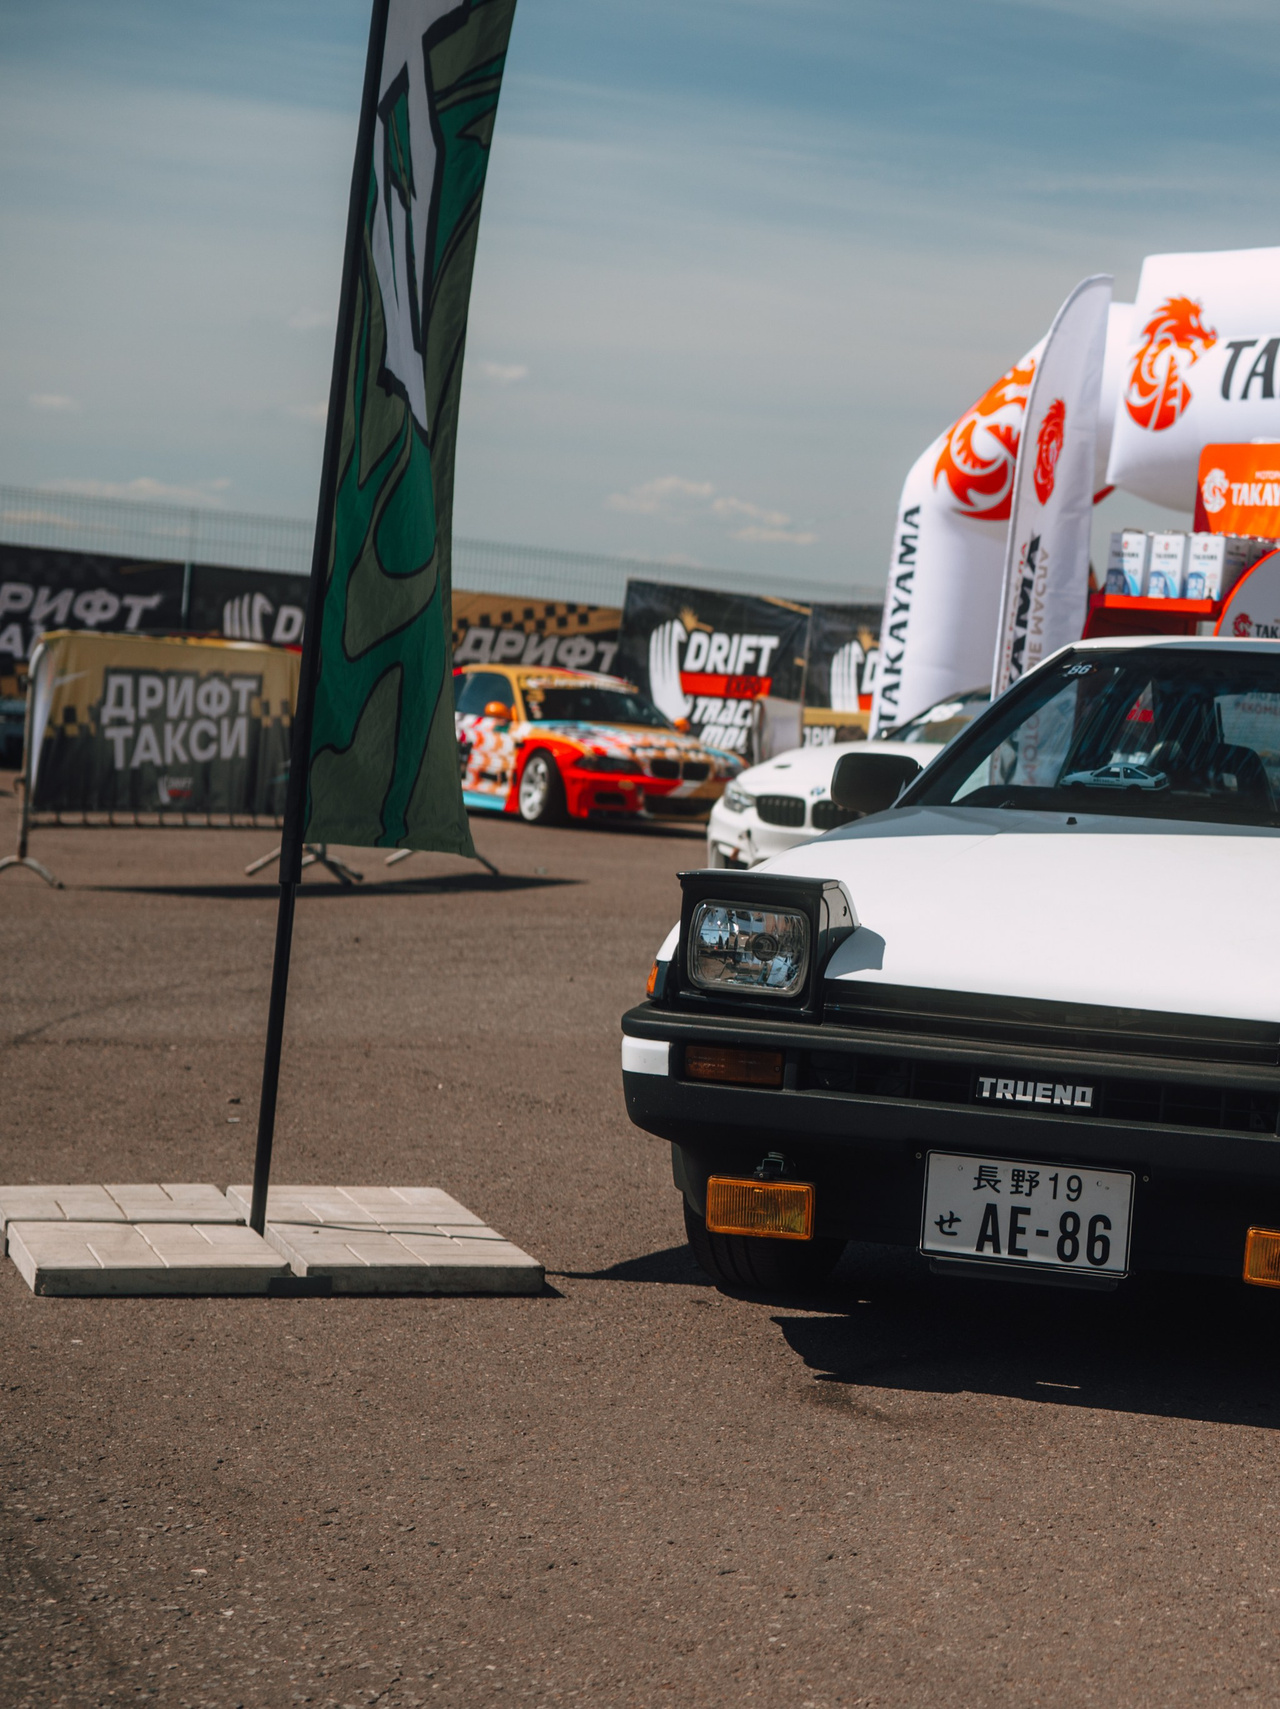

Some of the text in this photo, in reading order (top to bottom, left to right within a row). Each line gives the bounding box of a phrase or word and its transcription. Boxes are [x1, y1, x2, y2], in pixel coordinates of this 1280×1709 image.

[0, 581, 164, 631] РИФТ
[879, 505, 921, 723] TAKAYAMA
[454, 626, 619, 674] ДРИФТ
[683, 631, 780, 677] DRIFT
[1067, 664, 1093, 675] 86
[101, 673, 259, 724] ДРИФТ
[105, 717, 248, 770] ТАКСИ
[976, 1076, 1094, 1108] TRUENO
[973, 1164, 1083, 1202] 長野 19
[934, 1202, 1112, 1266] せ AE-86
